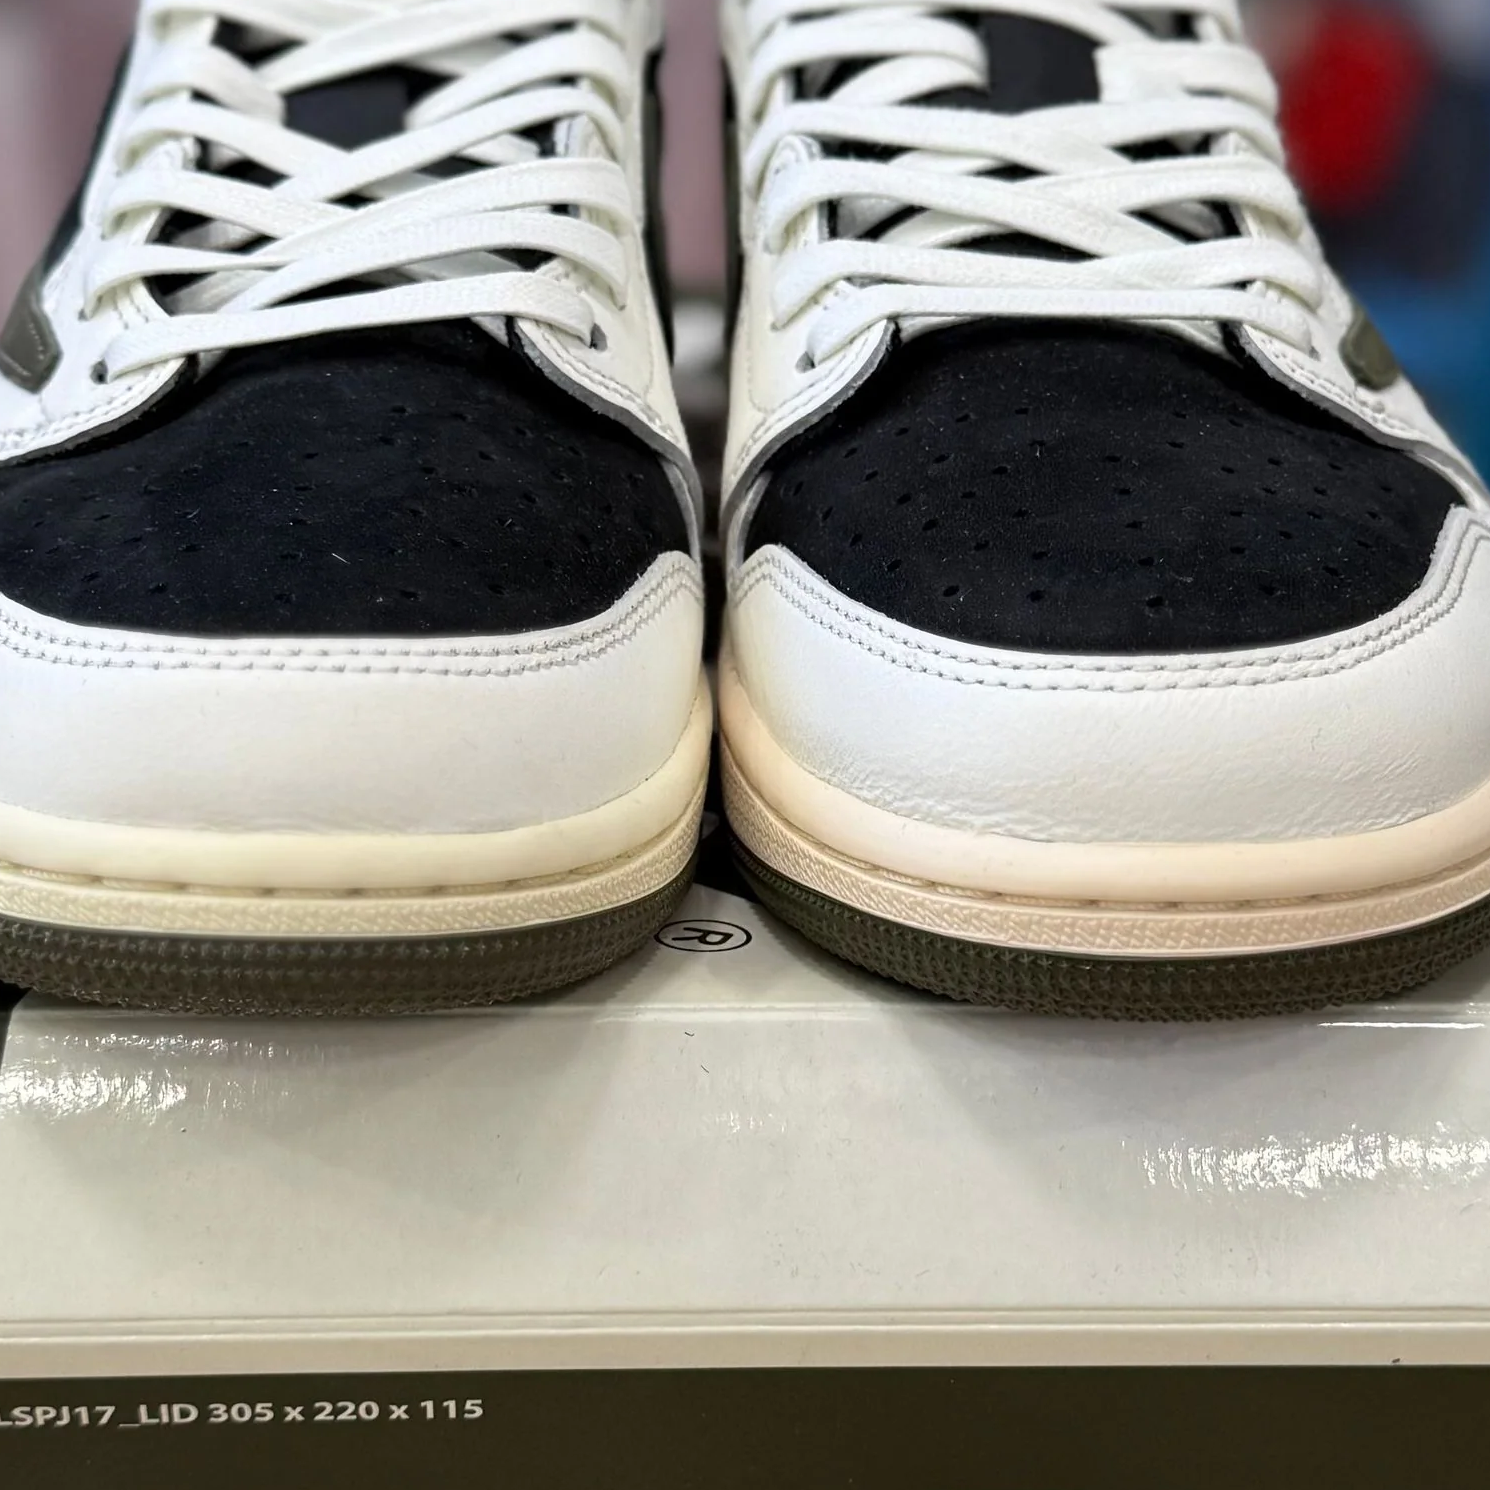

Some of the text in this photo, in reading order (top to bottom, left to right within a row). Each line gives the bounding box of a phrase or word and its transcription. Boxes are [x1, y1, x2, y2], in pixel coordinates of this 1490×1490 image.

[209, 1402, 274, 1423] 305
[284, 1405, 305, 1423] x
[313, 1401, 380, 1422] 220
[389, 1403, 410, 1421] x
[420, 1399, 483, 1420] 115
